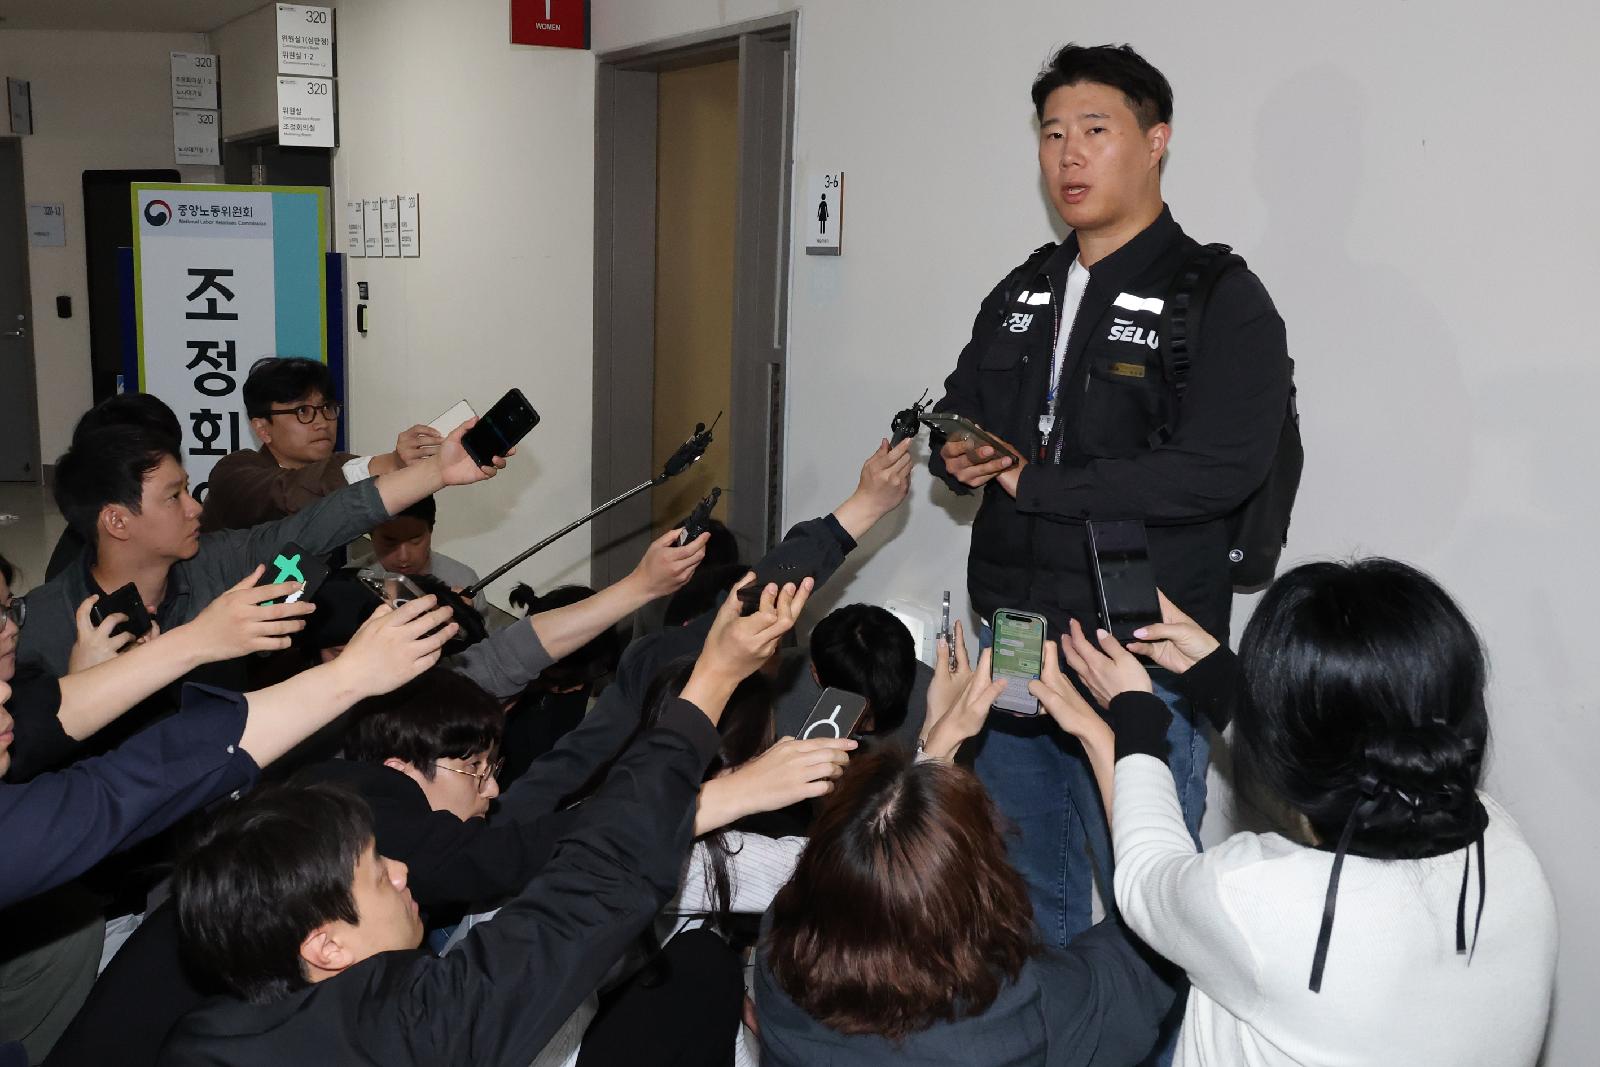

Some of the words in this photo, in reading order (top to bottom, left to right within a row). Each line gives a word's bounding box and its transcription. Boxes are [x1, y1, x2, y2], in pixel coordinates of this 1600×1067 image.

[305, 10, 327, 24] 320
[535, 22, 561, 31] WOMEN
[195, 57, 212, 67] 320
[282, 50, 302, 60] 위원실
[307, 81, 328, 95] 320
[282, 106, 302, 116] 위원실
[197, 113, 214, 124] 320
[824, 174, 839, 188] 3-6
[178, 204, 253, 218] 중앙노동위원회
[1002, 312, 1034, 333] 쟁
[1107, 325, 1159, 350] SELU
[185, 268, 240, 503] 조정회
